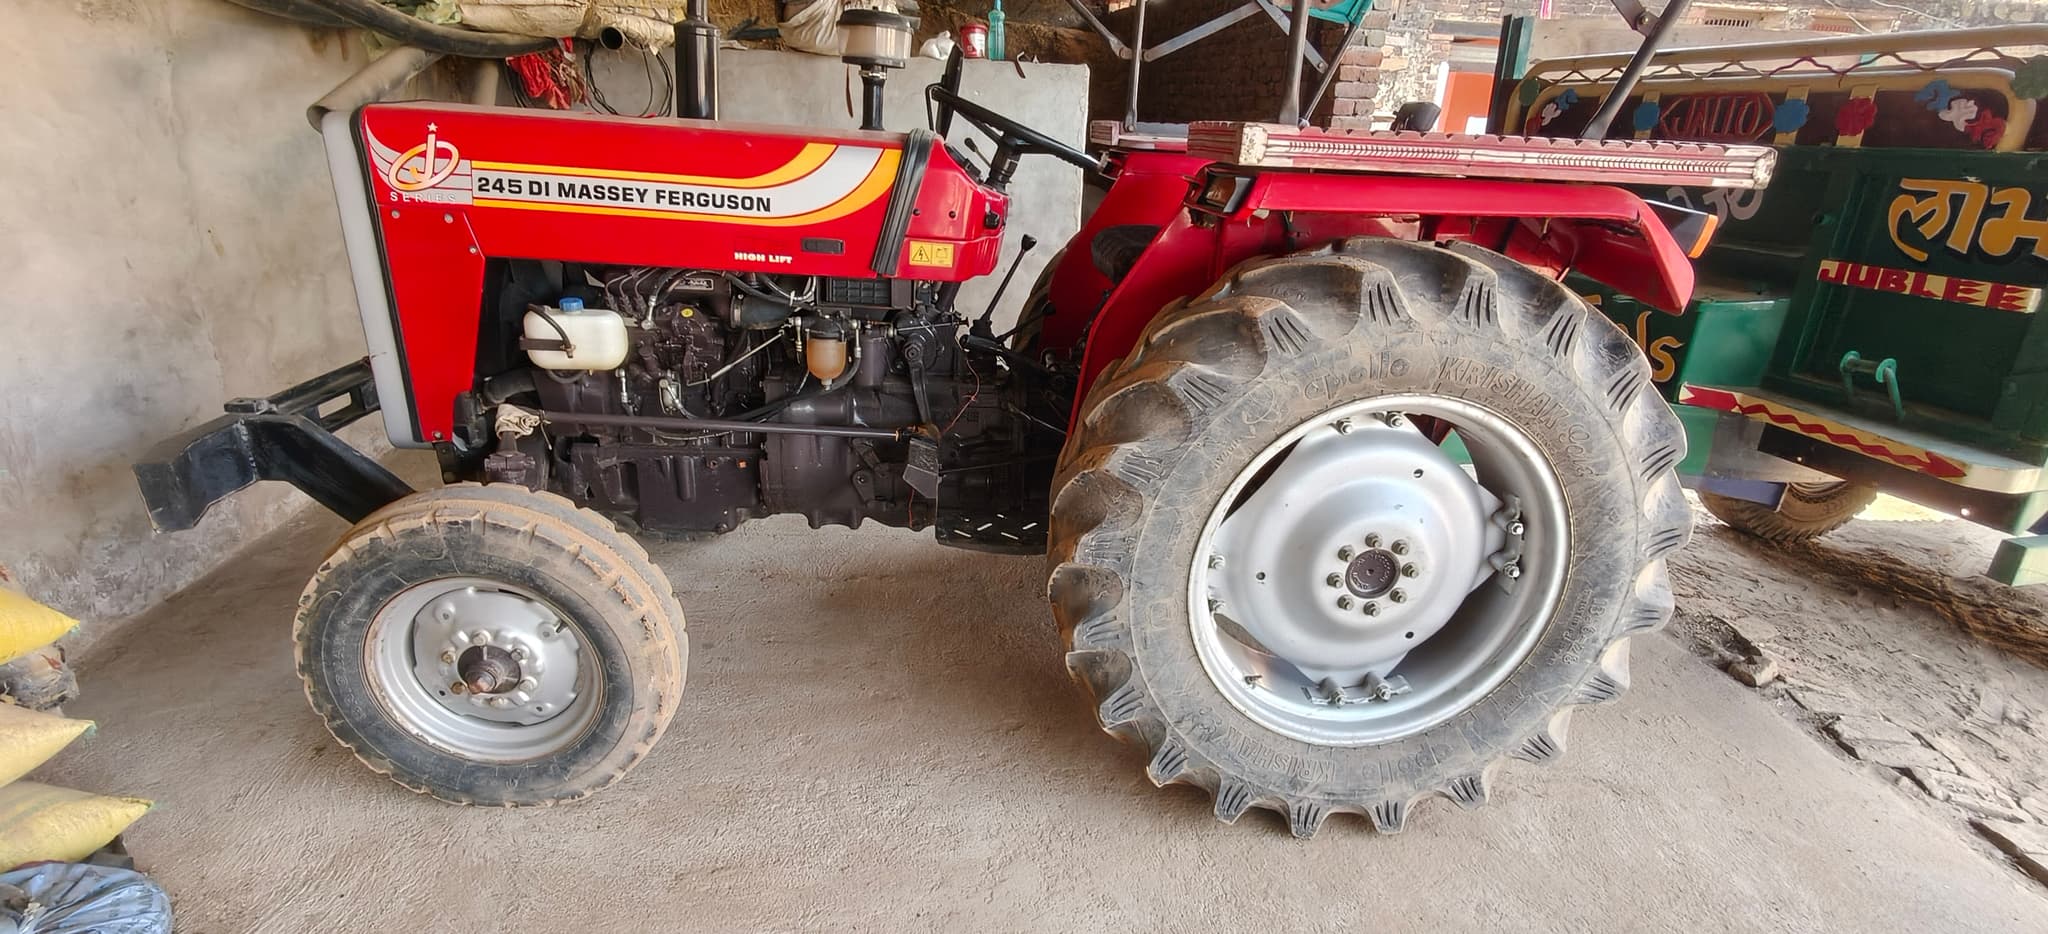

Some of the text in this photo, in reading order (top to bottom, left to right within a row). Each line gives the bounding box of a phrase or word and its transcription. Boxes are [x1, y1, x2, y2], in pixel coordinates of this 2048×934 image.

[389, 191, 457, 204] SERIES
[477, 176, 771, 213] 245 DI MASSEY FERGUSON
[734, 251, 793, 264] HIGH LIFT
[1818, 261, 2034, 314] JUBLEE
[1437, 356, 1572, 429] KRISHAK
[1227, 726, 1337, 783] KRISHAK
